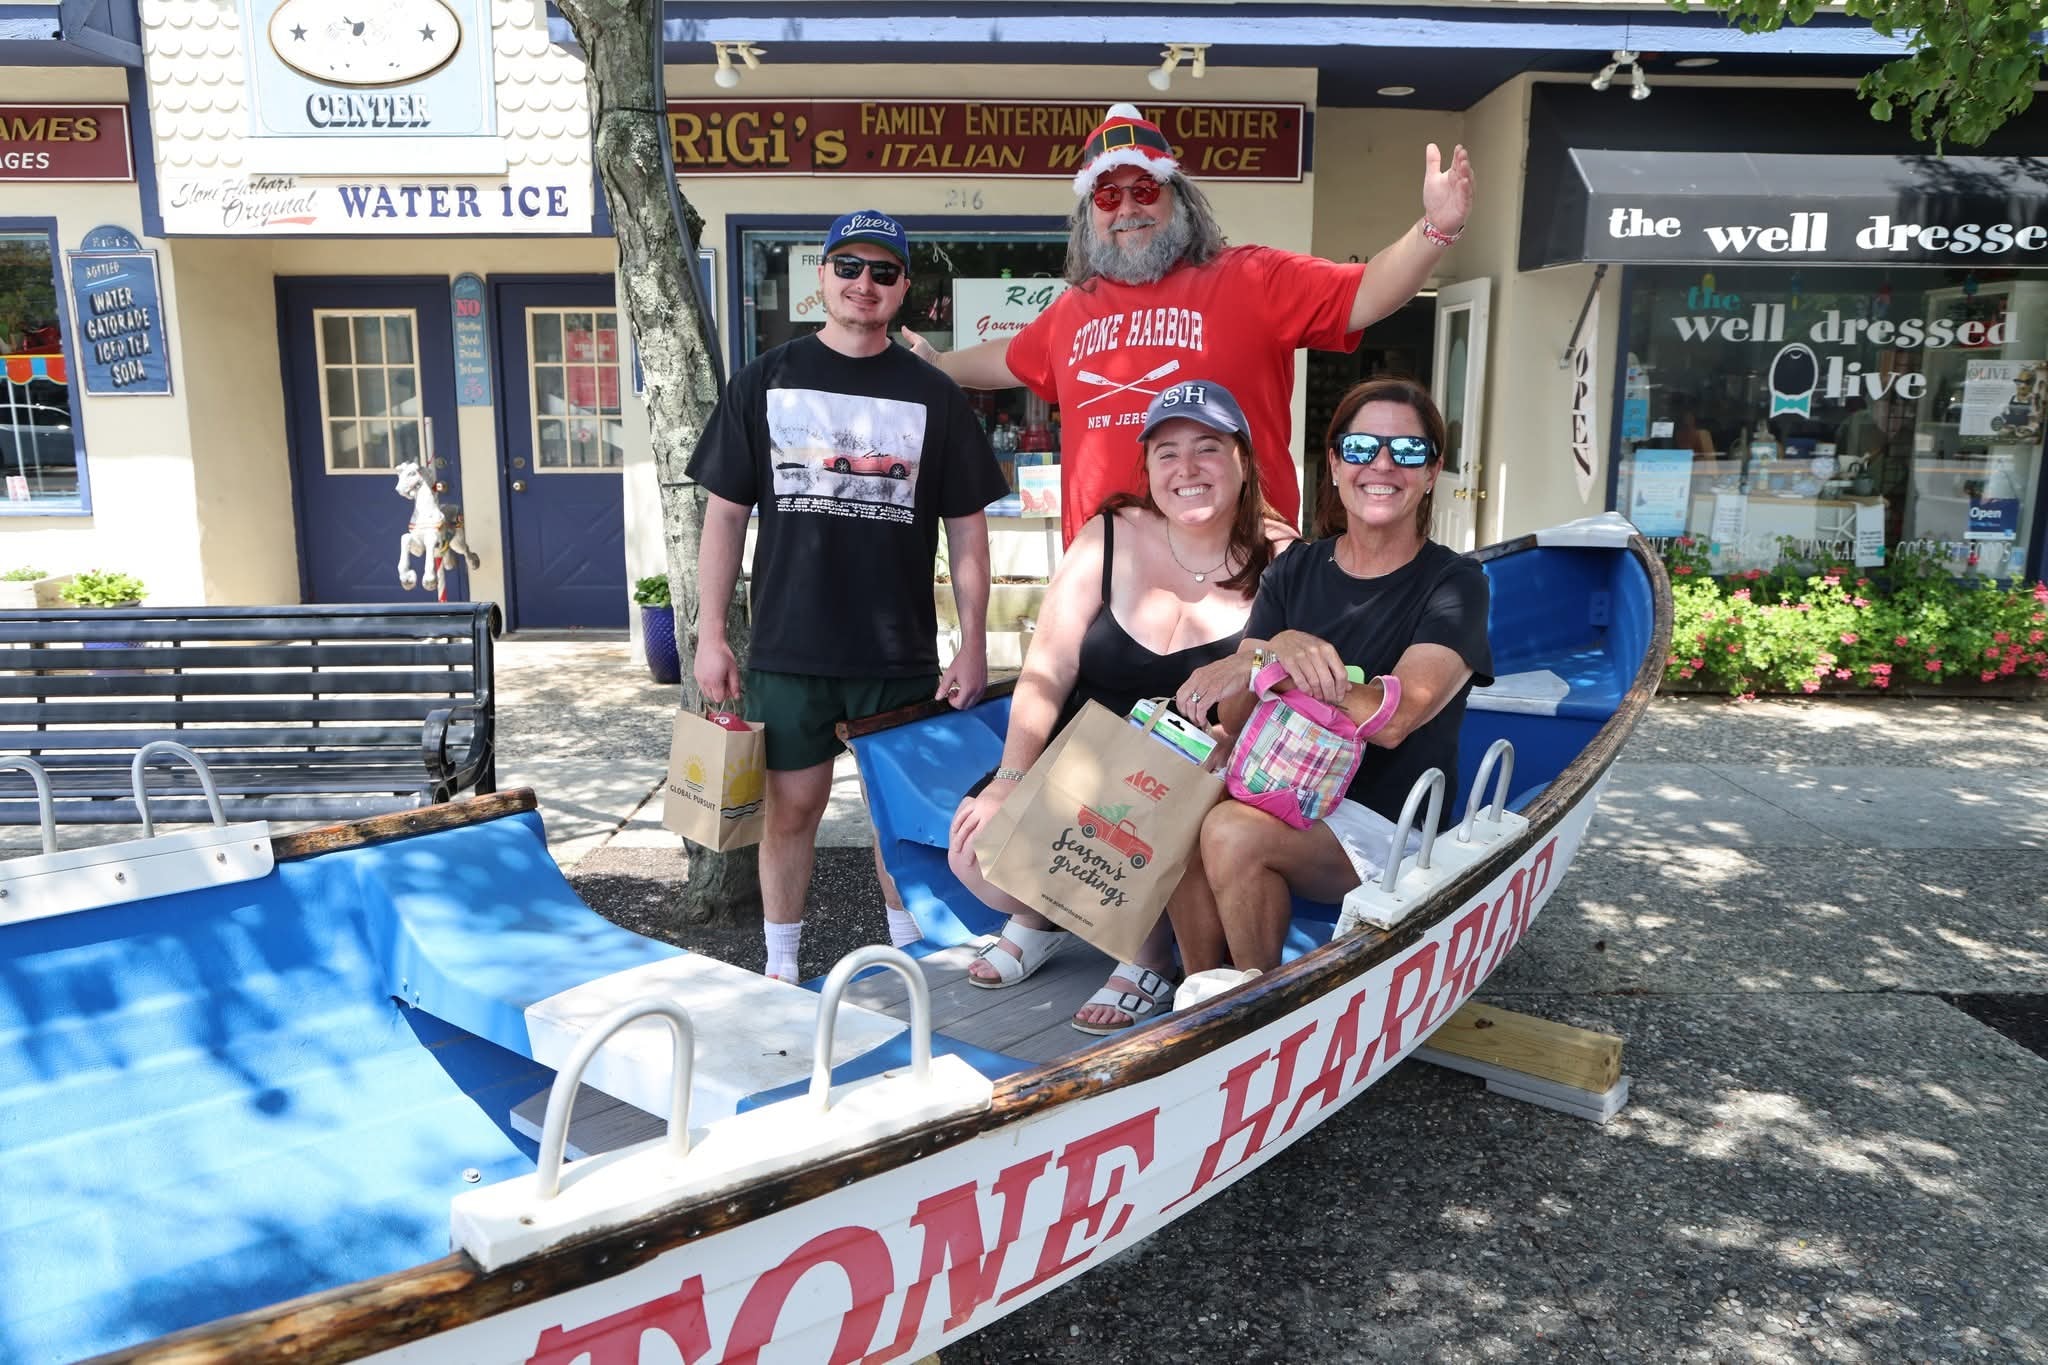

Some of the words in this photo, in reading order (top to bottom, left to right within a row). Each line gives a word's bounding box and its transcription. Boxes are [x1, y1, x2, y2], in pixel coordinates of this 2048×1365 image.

[306, 93, 432, 129] CENTER
[861, 103, 946, 136] FAMILY
[965, 104, 1166, 137] ENTERTAINT
[1175, 106, 1278, 139] CENTER
[668, 111, 848, 167] RiGi's
[0, 152, 50, 170] GES
[880, 143, 1025, 171] ITALIAN
[1200, 146, 1267, 172] ICE
[221, 189, 317, 228] Original
[337, 185, 483, 218] WATER
[500, 185, 569, 218] ICE
[841, 214, 897, 236] Sixers
[1608, 207, 1682, 239] the
[1703, 212, 1829, 253] well
[1855, 215, 2048, 254] dresse
[802, 254, 823, 266] FRE
[93, 286, 134, 313] WATER
[455, 298, 482, 318] NO
[1006, 285, 1054, 312] RiG
[1687, 286, 1740, 311] the
[86, 307, 151, 340] GATORADE
[976, 315, 1029, 336] Gourm
[1068, 313, 1125, 367] STONE
[1125, 307, 1203, 352] HARBOR
[1672, 303, 1786, 342] well
[1810, 310, 2019, 349] dressed
[97, 340, 125, 363] ICED
[127, 331, 151, 355] TEA
[112, 359, 146, 386] SODA
[1163, 385, 1207, 418] SH
[1088, 415, 1111, 429] NEW
[1115, 411, 1148, 426] JERS
[1970, 507, 2002, 520] Open
[670, 784, 692, 800] GLOBAL
[693, 795, 716, 811] PURSUIT
[1122, 769, 1170, 801] ACE
[1052, 827, 1126, 881] Season's
[1049, 854, 1129, 907] greetings
